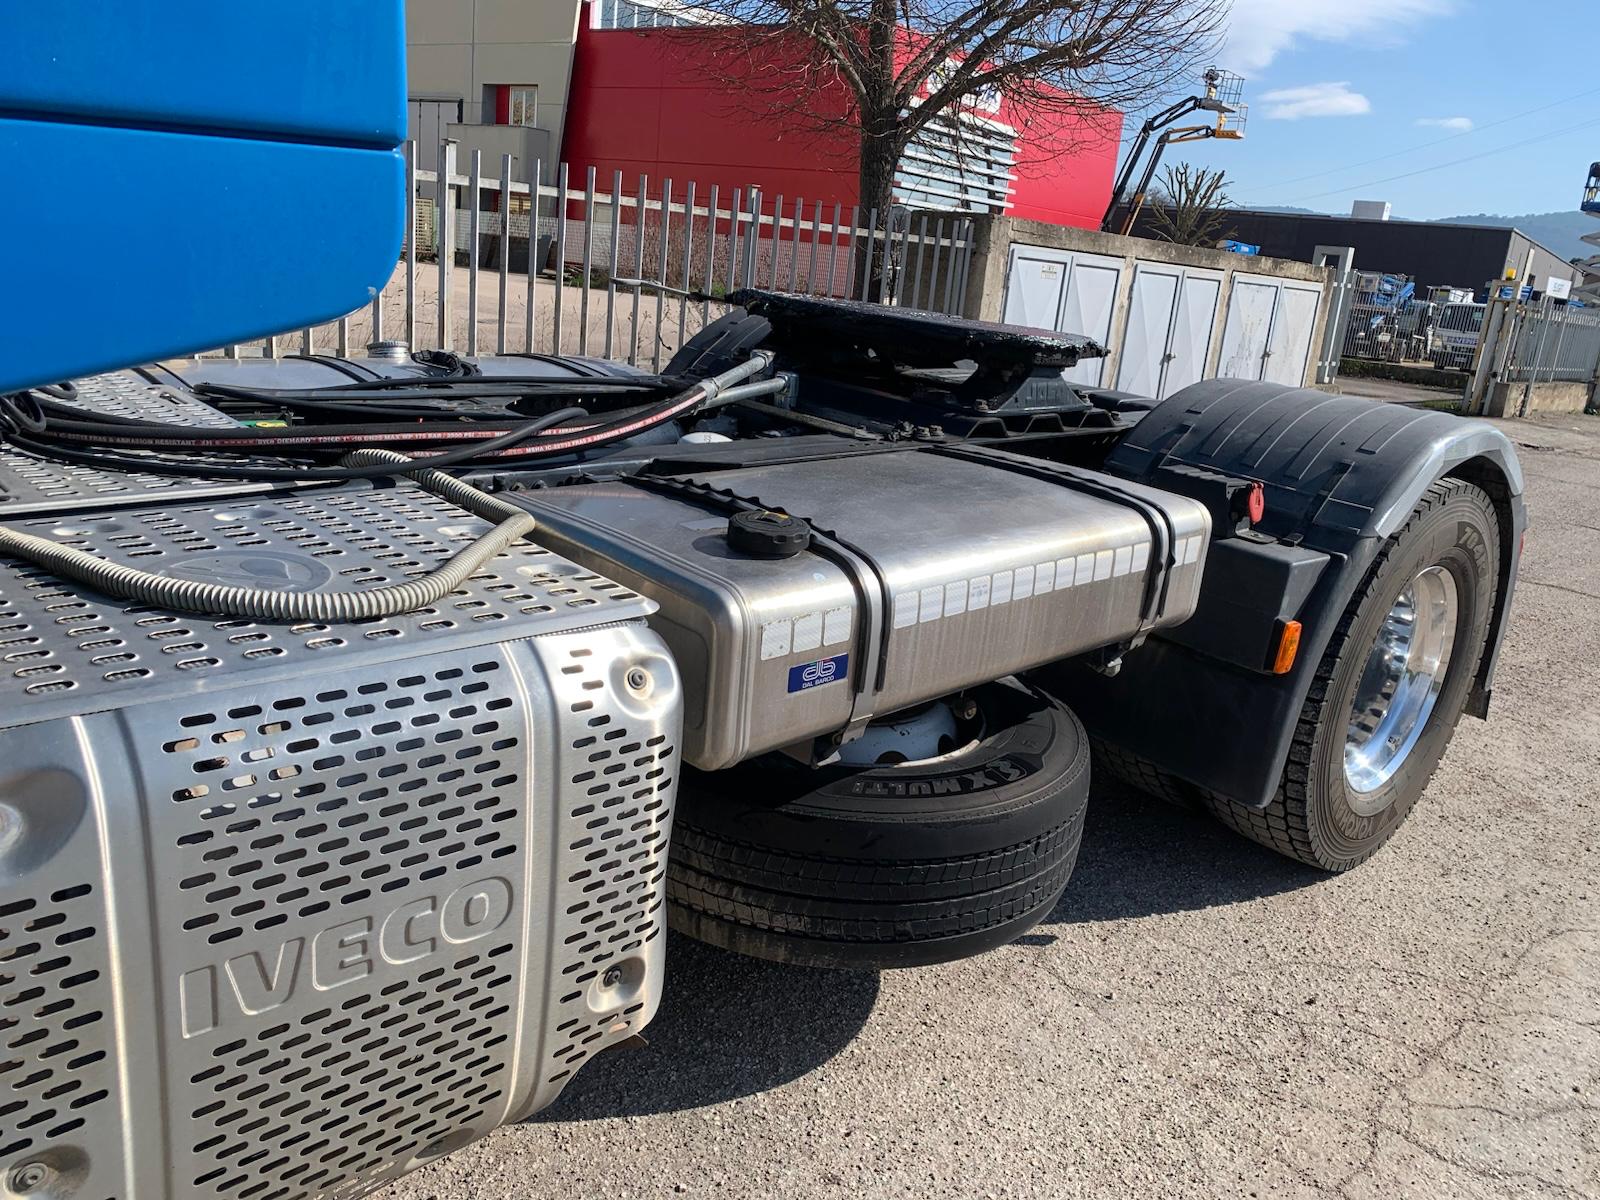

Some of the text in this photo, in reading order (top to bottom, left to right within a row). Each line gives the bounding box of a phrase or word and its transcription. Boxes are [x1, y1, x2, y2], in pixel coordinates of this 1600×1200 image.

[428, 432, 442, 440] BAR
[116, 437, 154, 445] ABRASION
[155, 438, 195, 446] RESISTANT
[802, 681, 814, 689] DAL
[179, 875, 514, 1040] IVECO
